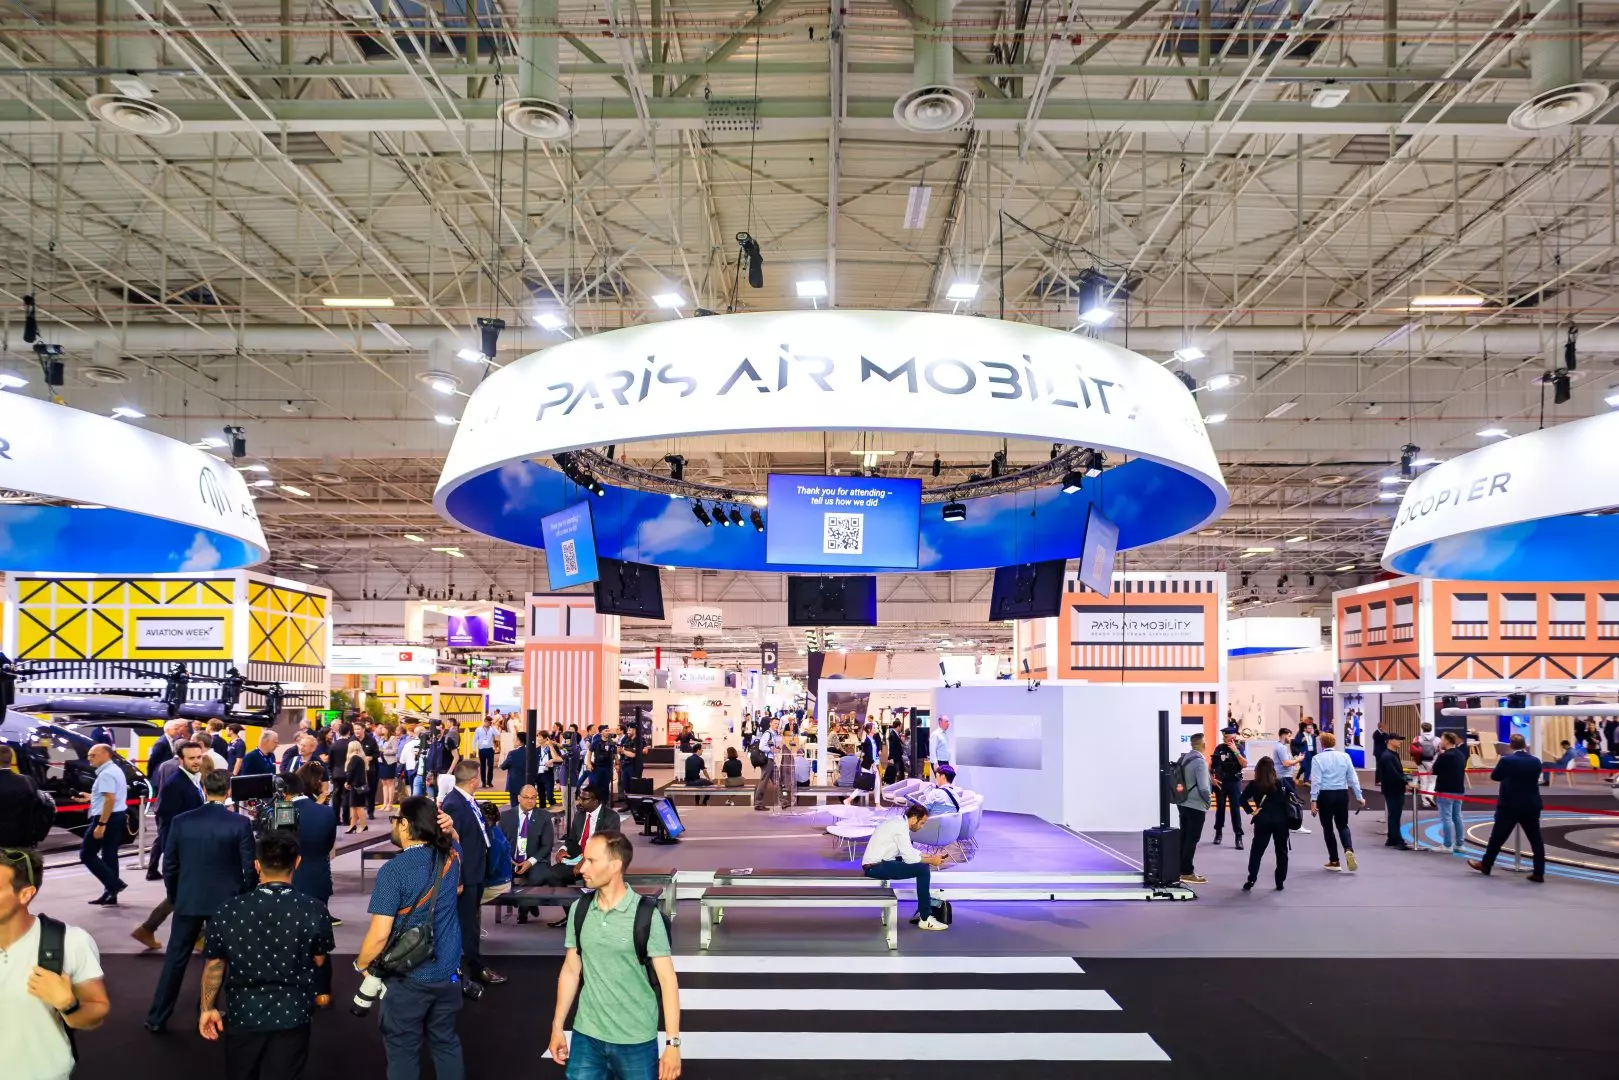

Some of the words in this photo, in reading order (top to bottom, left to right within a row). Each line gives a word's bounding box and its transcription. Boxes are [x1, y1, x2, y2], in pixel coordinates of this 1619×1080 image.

[536, 354, 698, 421] PARIS
[716, 343, 835, 393] AIR
[797, 486, 820, 495] Thank
[821, 487, 836, 497] you
[837, 488, 848, 496] for
[850, 488, 886, 499] attending
[811, 497, 823, 505] tell
[836, 497, 851, 506] how
[866, 498, 878, 507] did
[1091, 618, 1119, 630] PARIS
[1121, 618, 1138, 630] AIR
[1140, 618, 1191, 630] MOBILITY
[145, 628, 184, 637] AVIATION
[185, 628, 210, 637] WEEK
[764, 651, 776, 665] D
